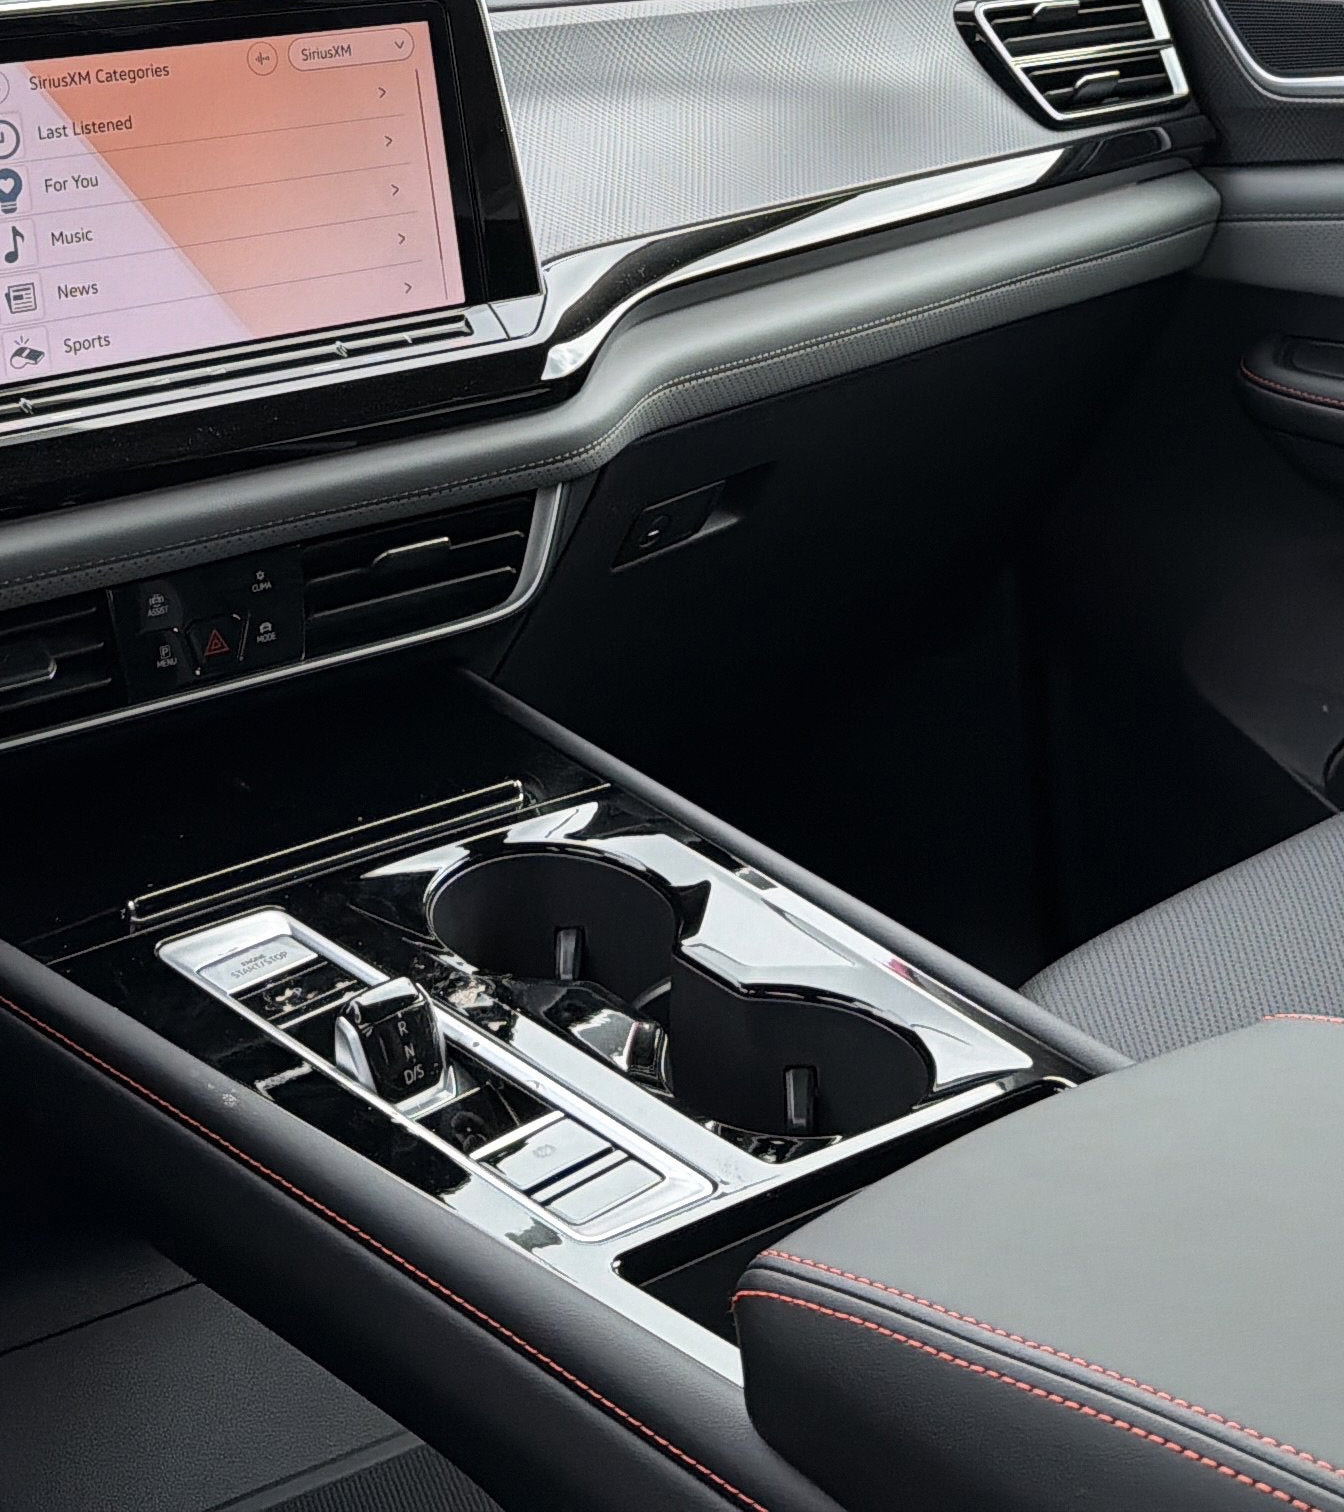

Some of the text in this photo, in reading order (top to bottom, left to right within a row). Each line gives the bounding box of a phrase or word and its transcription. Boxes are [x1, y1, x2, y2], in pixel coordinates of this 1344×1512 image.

[300, 44, 352, 63] SiriusXM
[29, 61, 170, 92] SiriusXM Categories
[37, 114, 133, 141] Last Listened
[44, 173, 99, 194] For You
[50, 226, 93, 246] Music
[56, 279, 99, 299] News
[63, 331, 111, 355] Sports
[147, 606, 168, 617] ASSIST
[256, 633, 276, 643] MODE
[156, 658, 177, 669] MENU
[397, 1020, 408, 1037] R
[404, 1043, 415, 1061] N
[403, 1064, 425, 1085] D/S
